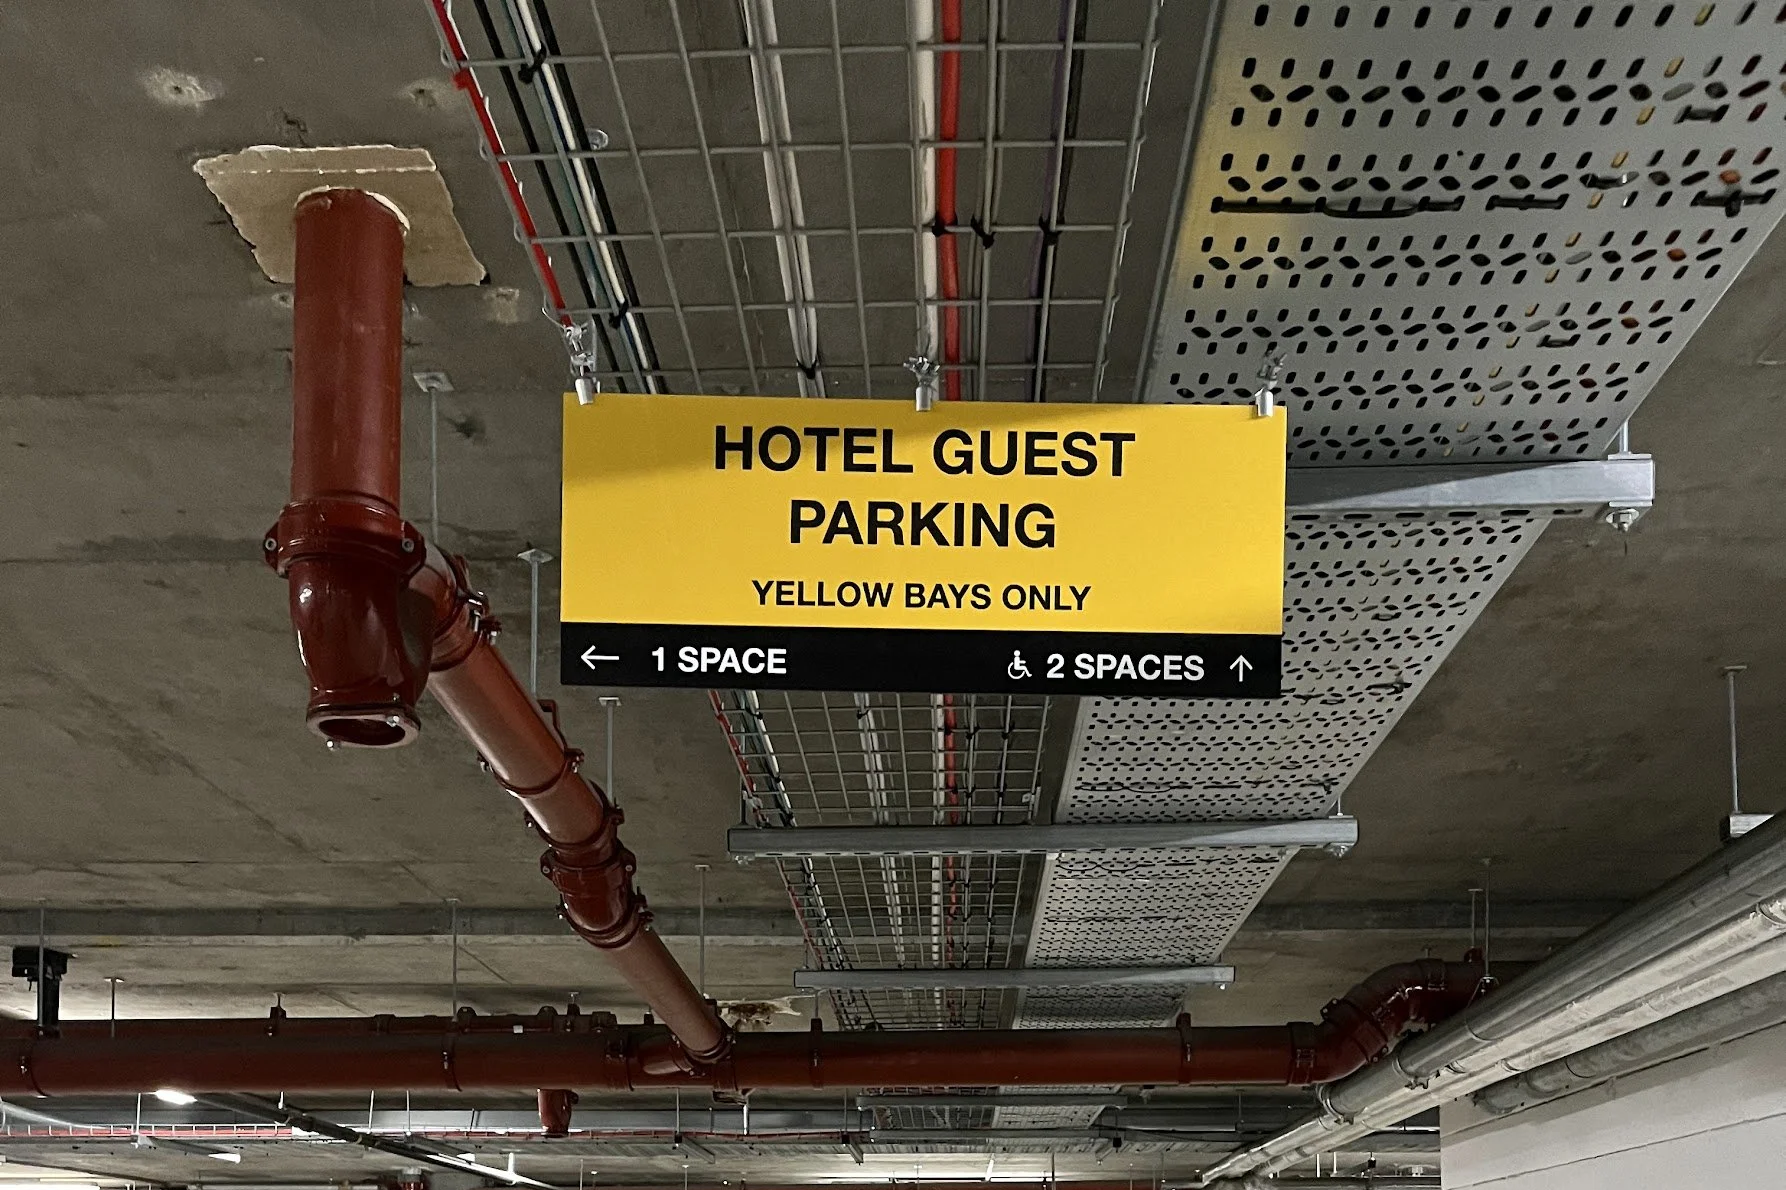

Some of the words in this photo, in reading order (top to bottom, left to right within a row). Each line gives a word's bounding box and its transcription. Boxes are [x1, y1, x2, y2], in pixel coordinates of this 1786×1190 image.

[715, 425, 914, 474] HOTEL
[932, 428, 1136, 477] GUEST
[789, 499, 1056, 550] PARKING
[751, 580, 895, 609] YELLOW
[905, 582, 992, 611] BAYS
[1002, 584, 1092, 612] ONLY
[651, 645, 665, 673] 1
[677, 645, 788, 675] SPACE
[1046, 652, 1065, 680] 2
[1073, 651, 1205, 682] SPACES
